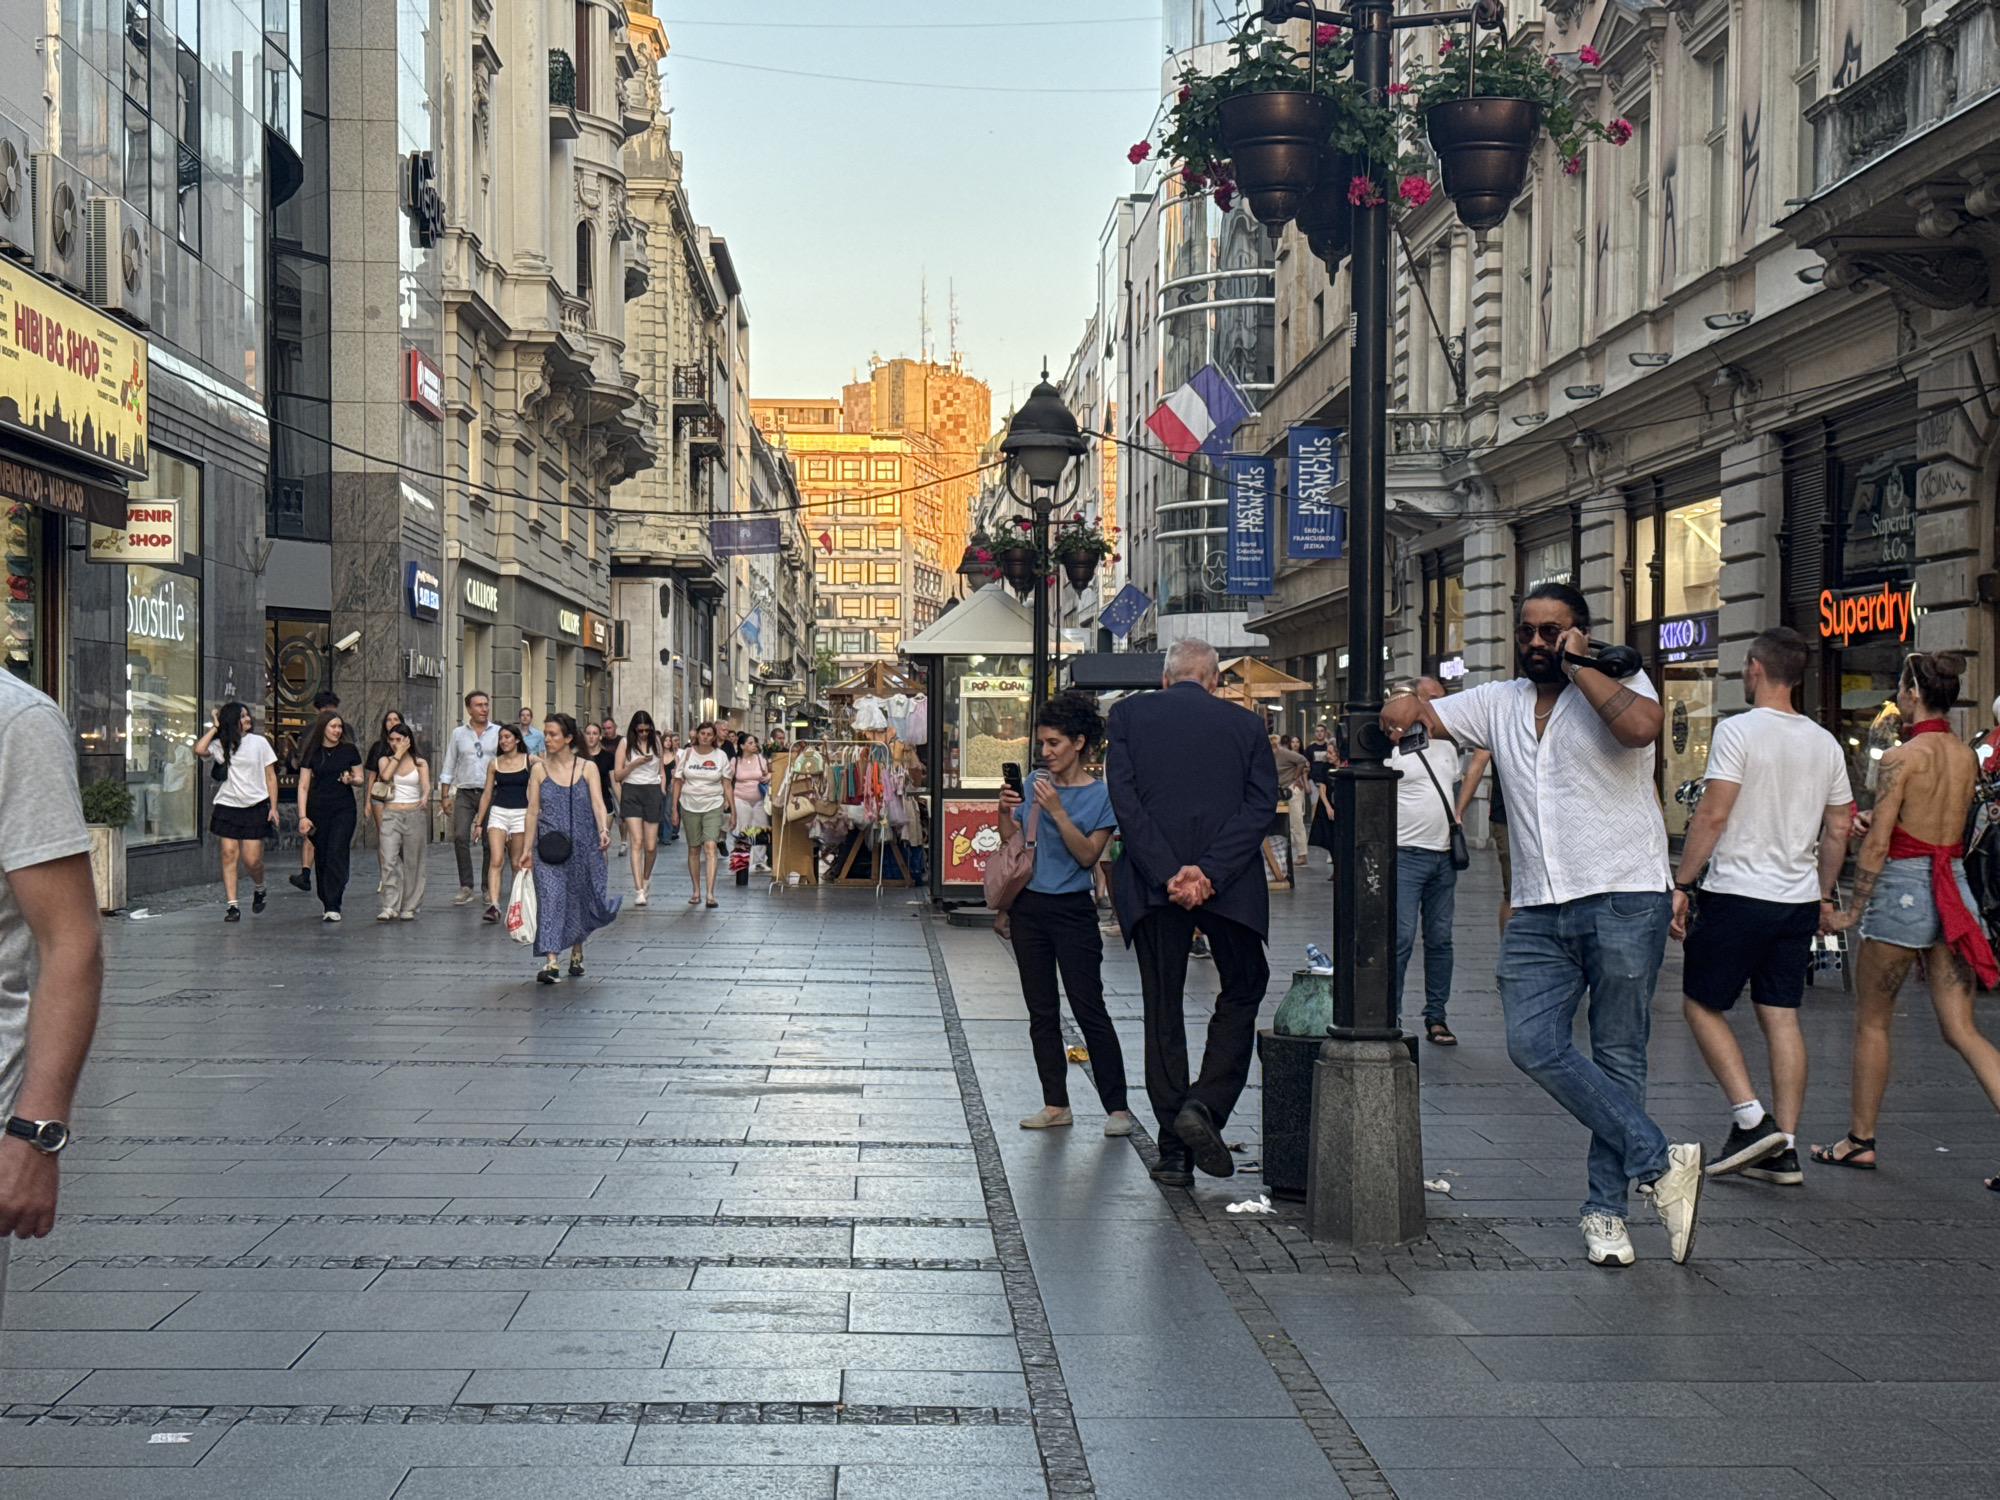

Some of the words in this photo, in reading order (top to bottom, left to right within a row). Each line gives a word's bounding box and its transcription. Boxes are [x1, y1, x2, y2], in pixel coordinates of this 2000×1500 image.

[14, 300, 44, 358] HIBI
[45, 316, 65, 367] BG
[66, 327, 100, 382] SHOP
[1298, 444, 1317, 515] INSTITUT
[1312, 437, 1335, 515] FRANÇAIS
[49, 476, 65, 508] MAP
[65, 481, 84, 513] SHOP
[1236, 472, 1252, 533] INSTITUT
[1249, 466, 1267, 533] FRANÇAIS
[129, 534, 172, 547] SHOP
[1872, 508, 1918, 542] Superdry
[1303, 543, 1325, 551] JEZIKA
[466, 577, 498, 613] CALLIOPE
[1819, 582, 1910, 647] Superdry
[1660, 619, 1694, 650] KIKO
[777, 695, 787, 706] R
[999, 680, 1025, 691] CORN
